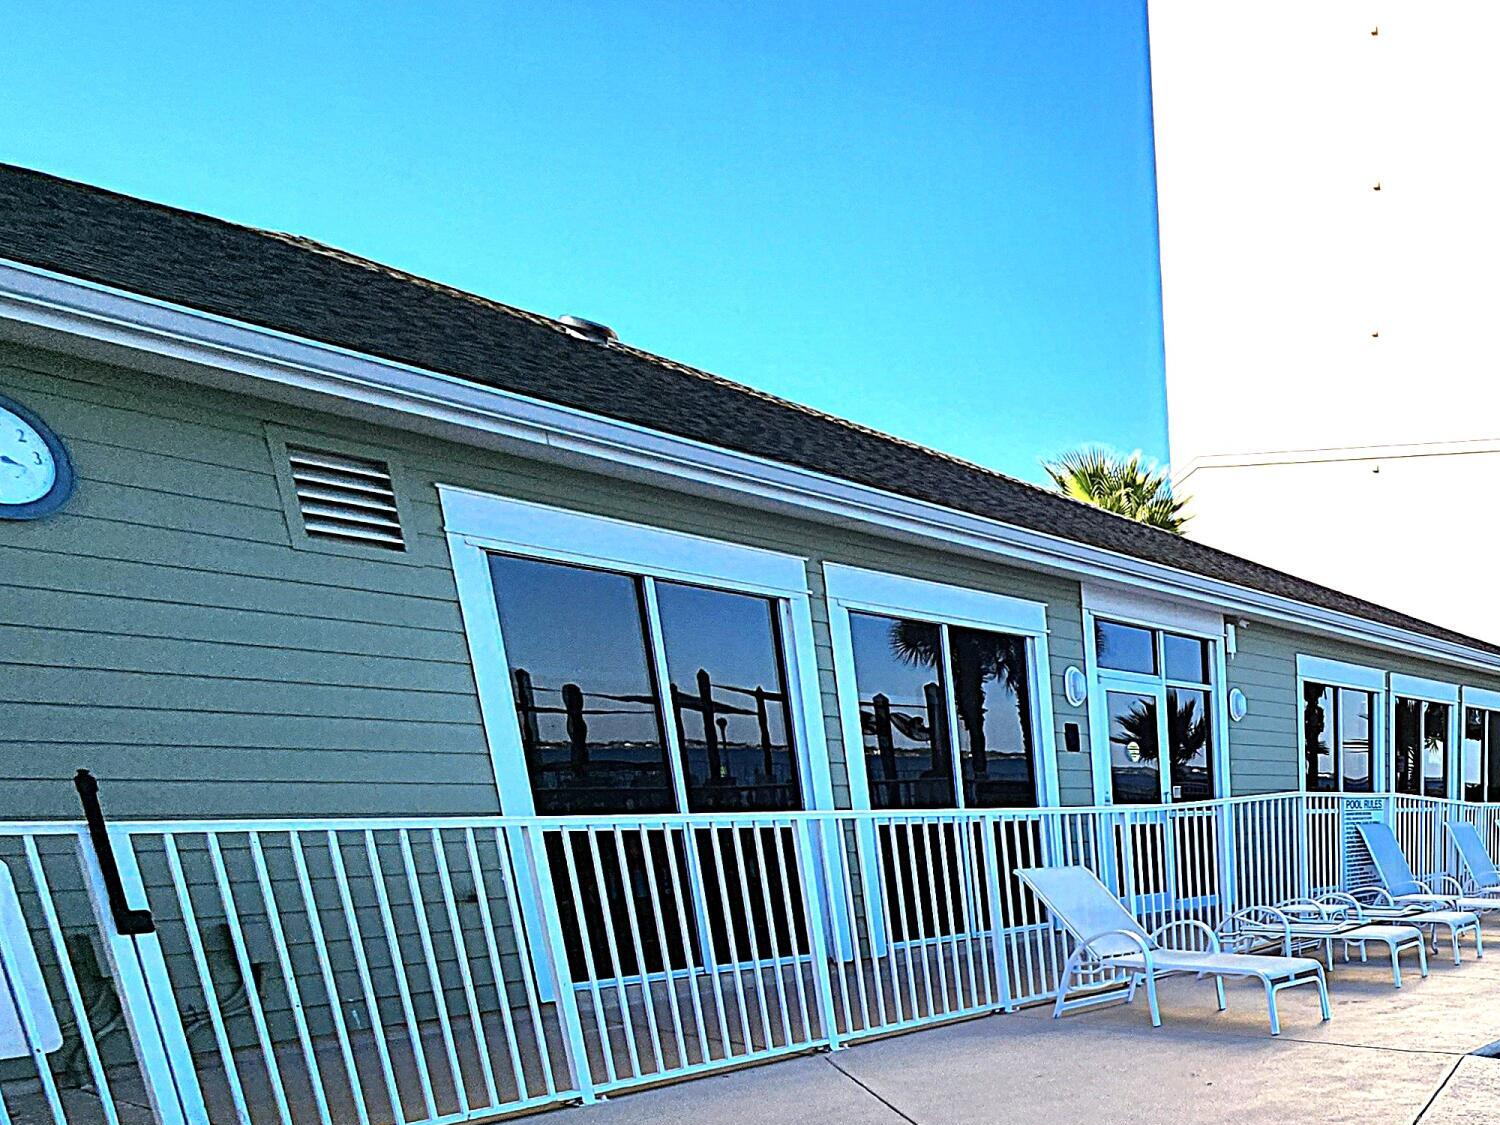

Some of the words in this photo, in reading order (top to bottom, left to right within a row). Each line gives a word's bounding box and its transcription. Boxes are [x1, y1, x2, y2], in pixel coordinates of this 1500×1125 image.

[16, 428, 27, 443] 2
[33, 451, 42, 465] 3
[1346, 799, 1362, 809] POOL
[1364, 799, 1383, 809] RULES
